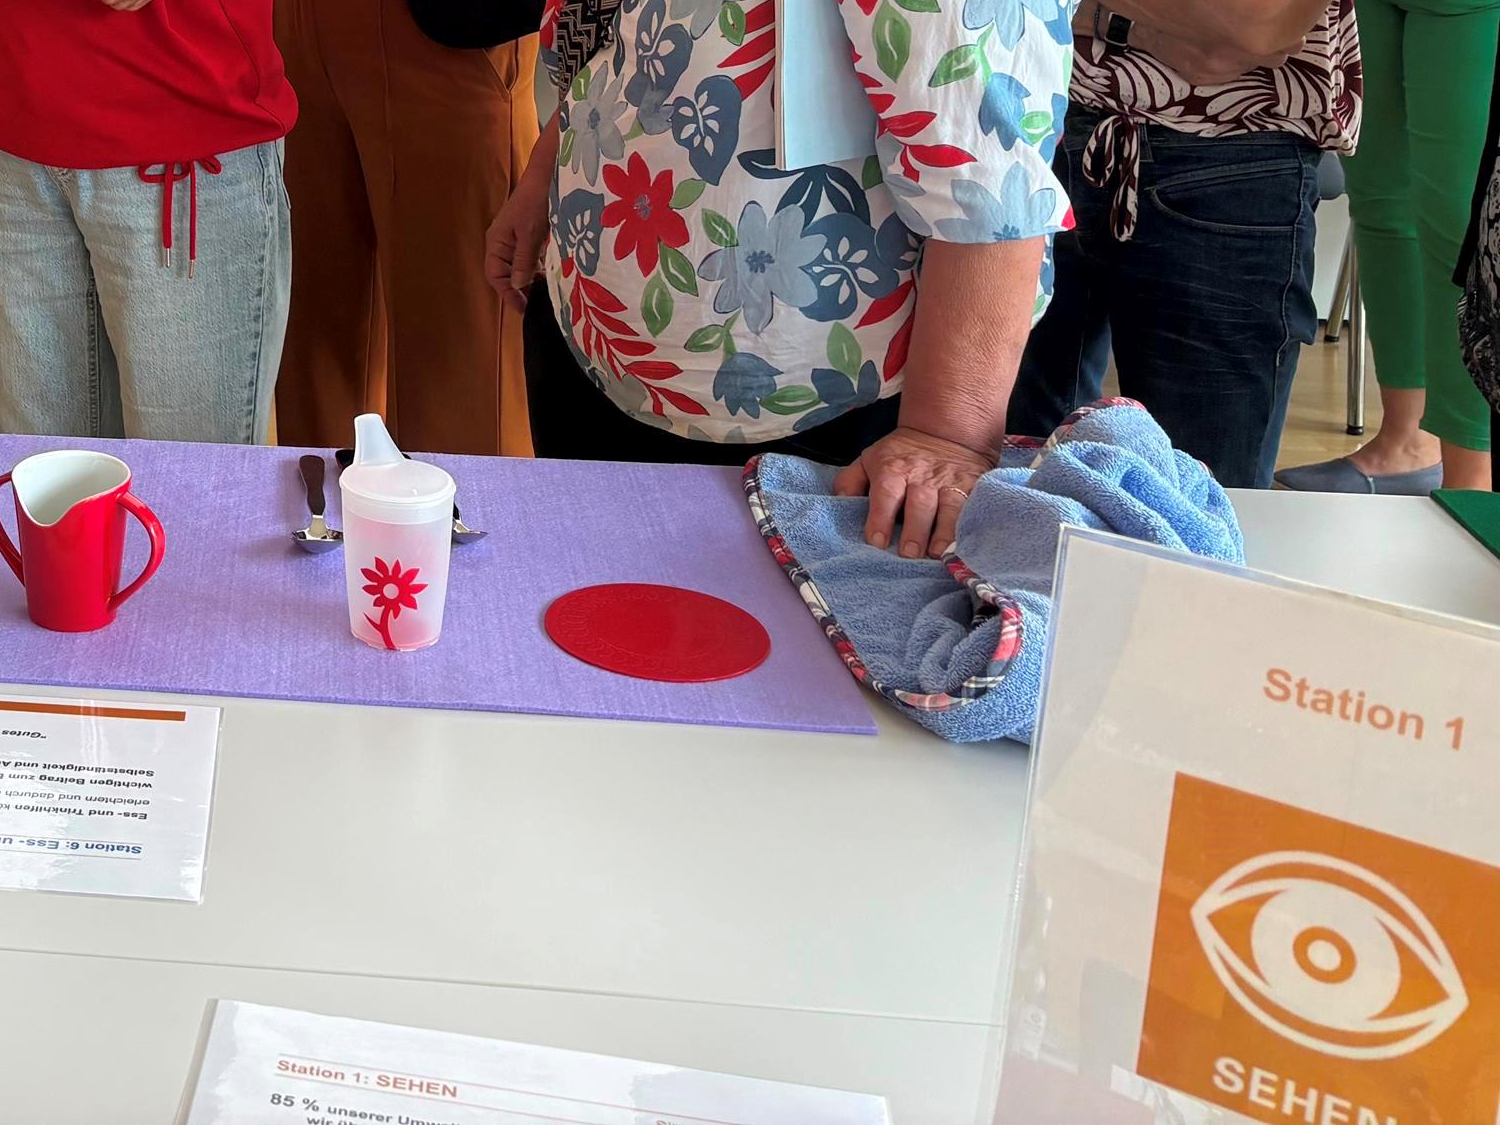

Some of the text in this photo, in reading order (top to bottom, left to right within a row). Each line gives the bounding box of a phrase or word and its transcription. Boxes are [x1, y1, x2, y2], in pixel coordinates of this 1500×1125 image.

[1263, 668, 1468, 752] Station 1
[37, 774, 85, 784] Beitrag
[88, 777, 151, 788] wichtigen
[4, 790, 54, 799] dadurch
[57, 793, 81, 801] und
[13, 804, 84, 815] Trinkhilfen
[116, 811, 147, 819] Ess-
[17, 838, 59, 849] Ess-
[65, 841, 79, 849] 6:
[84, 842, 141, 854] Station
[276, 1059, 458, 1098] Station 1: SEHEN
[270, 1093, 296, 1107] 85
[302, 1098, 320, 1112] %
[327, 1106, 393, 1123] unserer
